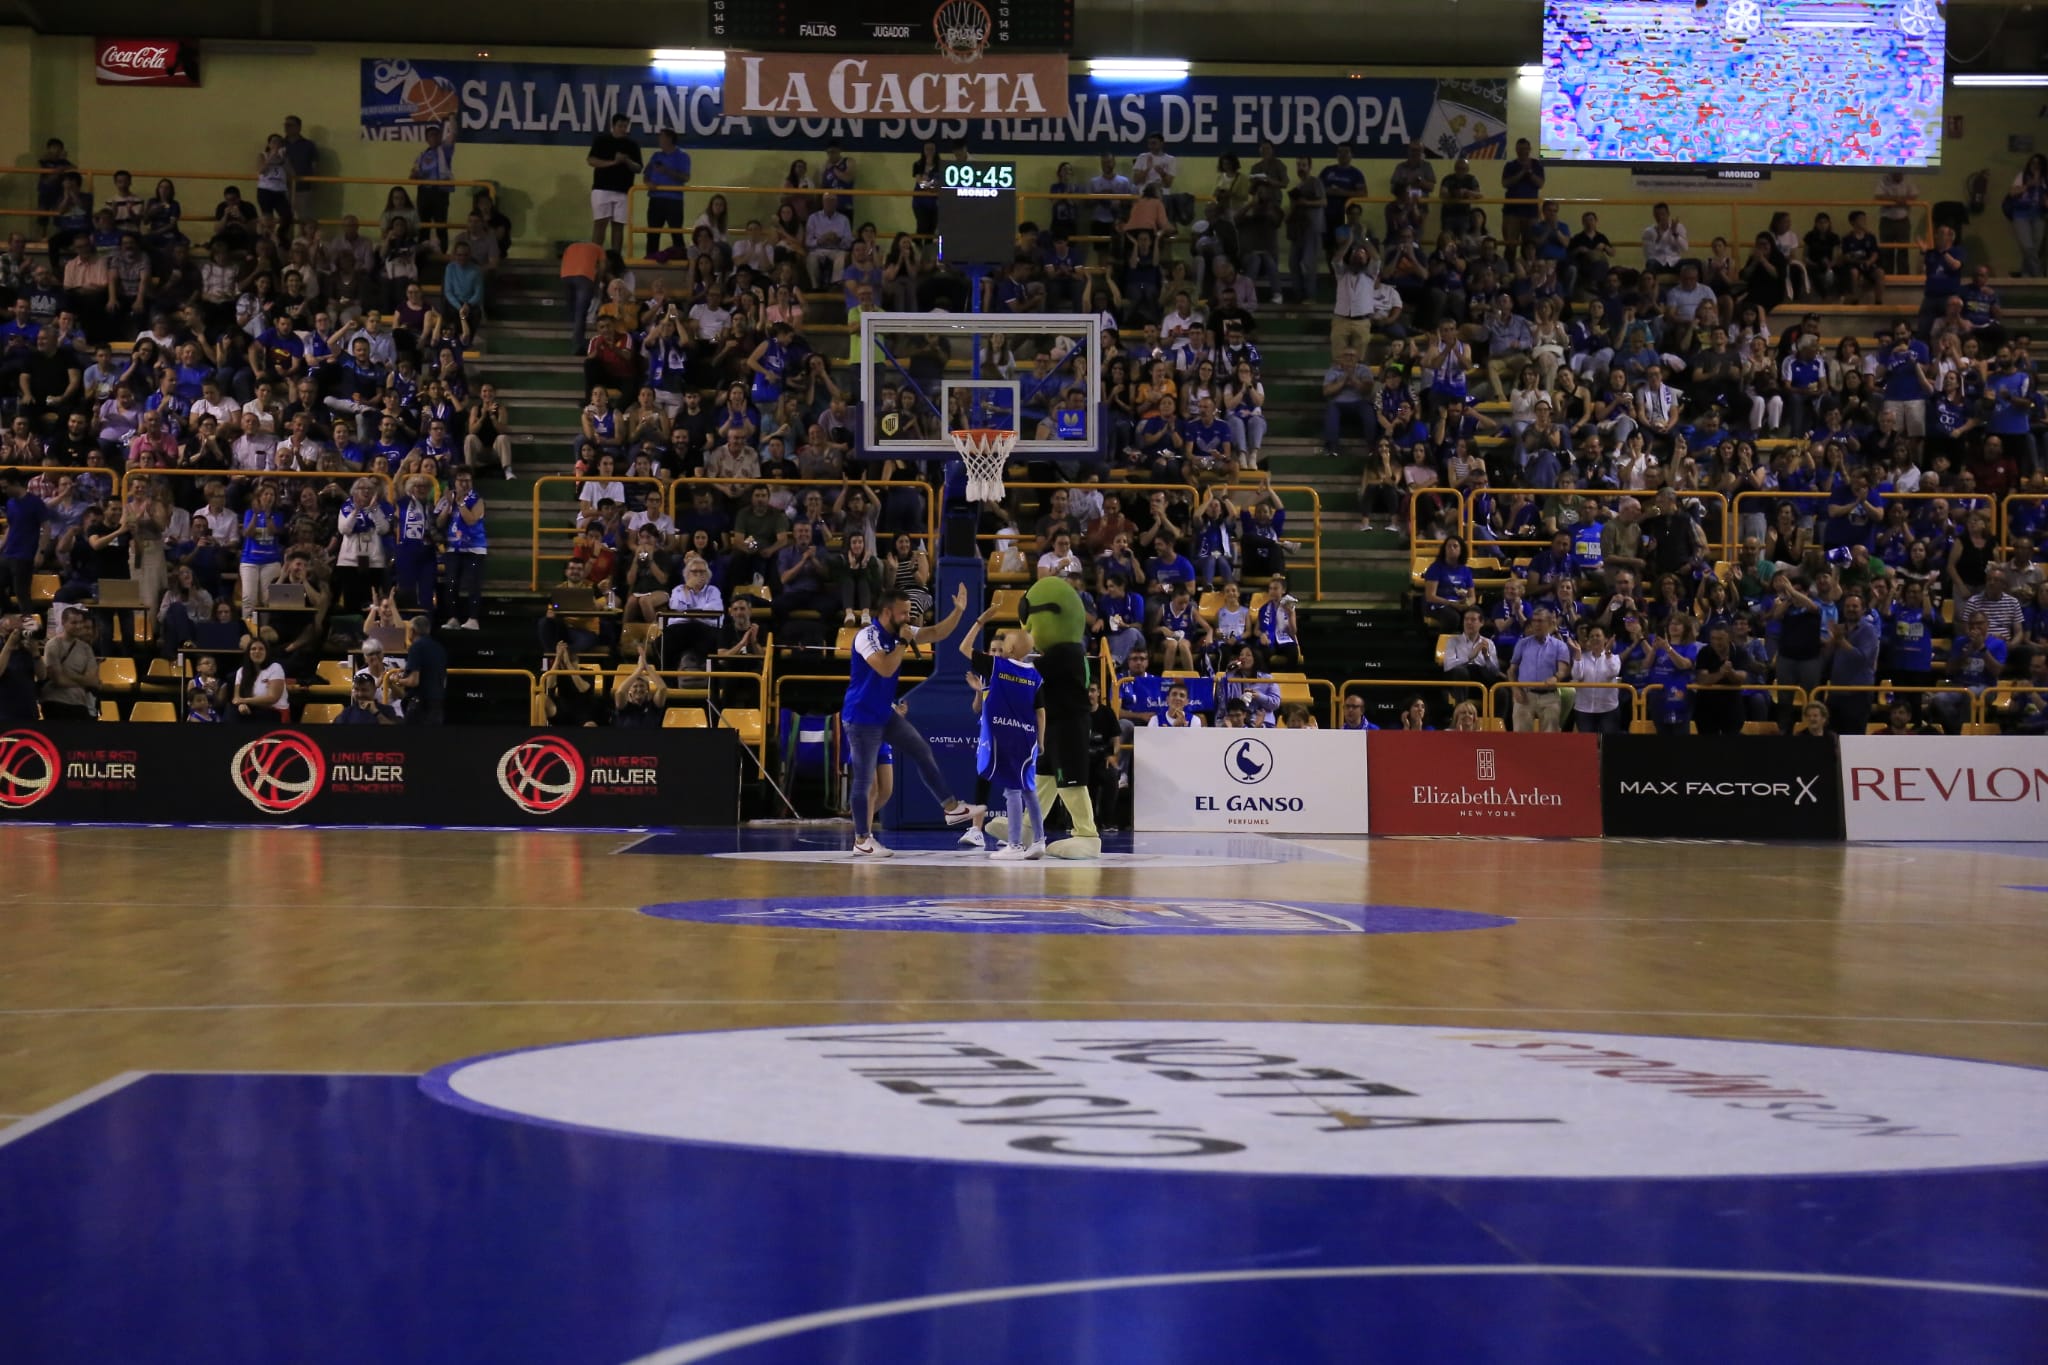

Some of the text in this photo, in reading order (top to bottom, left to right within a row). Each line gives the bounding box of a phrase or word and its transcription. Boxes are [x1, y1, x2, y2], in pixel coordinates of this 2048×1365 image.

[713, 1, 725, 10] 13
[713, 13, 724, 22] 14
[998, 8, 1009, 16] 13
[713, 25, 725, 35] 15
[799, 25, 837, 37] FALTAS
[873, 26, 910, 38] JUGADOR
[998, 32, 1009, 41] 15
[101, 46, 168, 68] Coca-Cola
[1160, 95, 1218, 143] DE
[1233, 95, 1411, 145] EUROPA
[945, 165, 1013, 188] 09:45
[1724, 171, 1760, 179] MONDO
[957, 188, 998, 197] MONDO
[929, 736, 963, 744] CASTILLA
[332, 752, 405, 763] UNIVERSO
[591, 756, 658, 767] UNIVERSO
[67, 763, 136, 778] MUJER
[332, 766, 404, 781] MUJER
[591, 769, 657, 784] MUJER
[1620, 781, 1678, 794] MAX
[1686, 782, 1791, 796] FACTOR
[1412, 786, 1562, 806] Elizabeth Arden
[1195, 795, 1304, 811] EL GANSO
[786, 1031, 1247, 1158] CASTILLA
